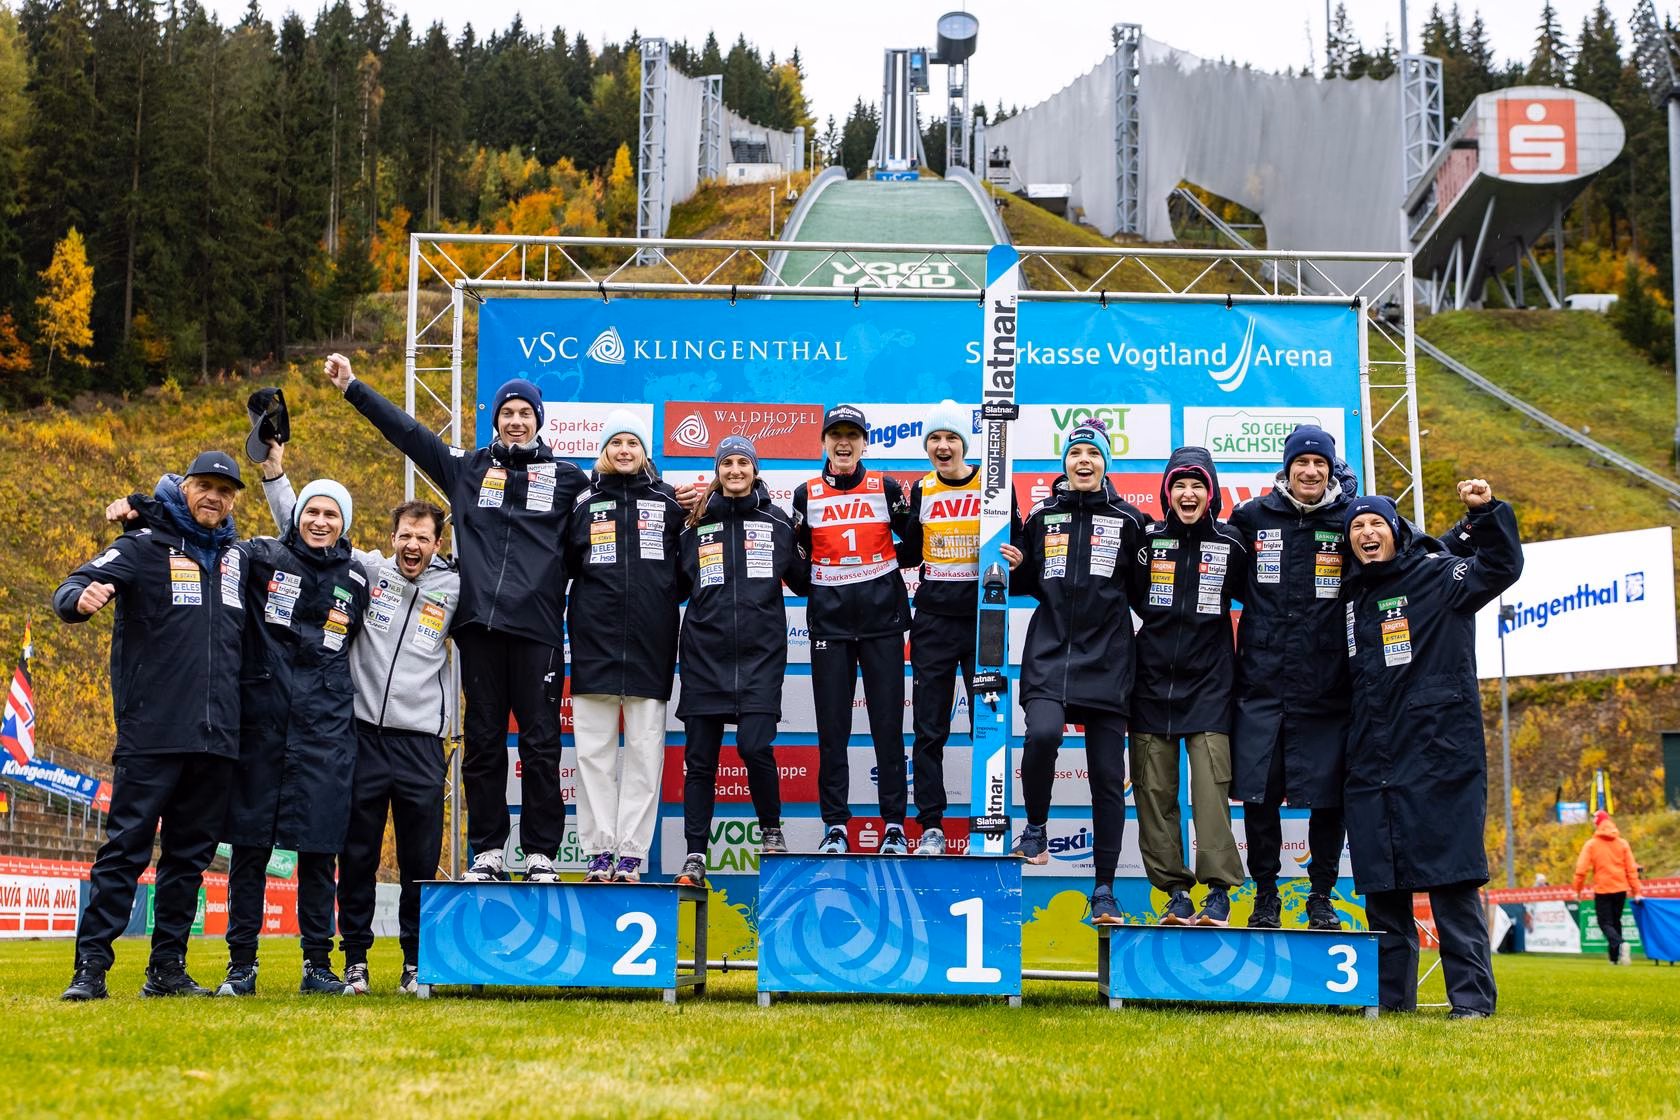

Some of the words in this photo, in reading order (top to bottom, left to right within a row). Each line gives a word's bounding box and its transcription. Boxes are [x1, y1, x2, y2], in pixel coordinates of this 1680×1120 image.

[831, 262, 958, 275] VOGT
[833, 274, 955, 288] LAND
[517, 331, 579, 363] VSC
[633, 339, 849, 361] KLINGENTHAL
[985, 300, 1016, 404] latnar
[966, 341, 1101, 365] Srkasse
[1107, 342, 1226, 371] Vogtland
[1254, 343, 1332, 366] Arena
[714, 410, 818, 424] WALDHOTEL
[1242, 423, 1260, 435] SO
[1054, 433, 1129, 456] LD
[1213, 434, 1285, 452] SÄCHSIS
[989, 422, 1000, 487] INOTHERM
[841, 528, 857, 552] 1
[1264, 541, 1281, 549] triglav
[824, 571, 862, 582] Sparkasse
[863, 562, 890, 576] Vogtland
[1264, 563, 1279, 571] hse
[933, 570, 970, 578] Sparkasse
[182, 583, 200, 591] ELES
[278, 585, 299, 596] triglav
[1156, 584, 1172, 593] ELES
[184, 594, 201, 603] hse
[1157, 596, 1171, 604] hse
[275, 606, 291, 618] hse
[376, 611, 390, 622] hse
[789, 627, 809, 637] Are
[1392, 643, 1410, 653] ELES
[973, 675, 997, 684] latnar.
[26, 883, 50, 908] AVIA
[54, 885, 77, 909] AVIA
[613, 911, 658, 976] 2
[946, 897, 1003, 983] 1
[1326, 944, 1360, 993] 3
